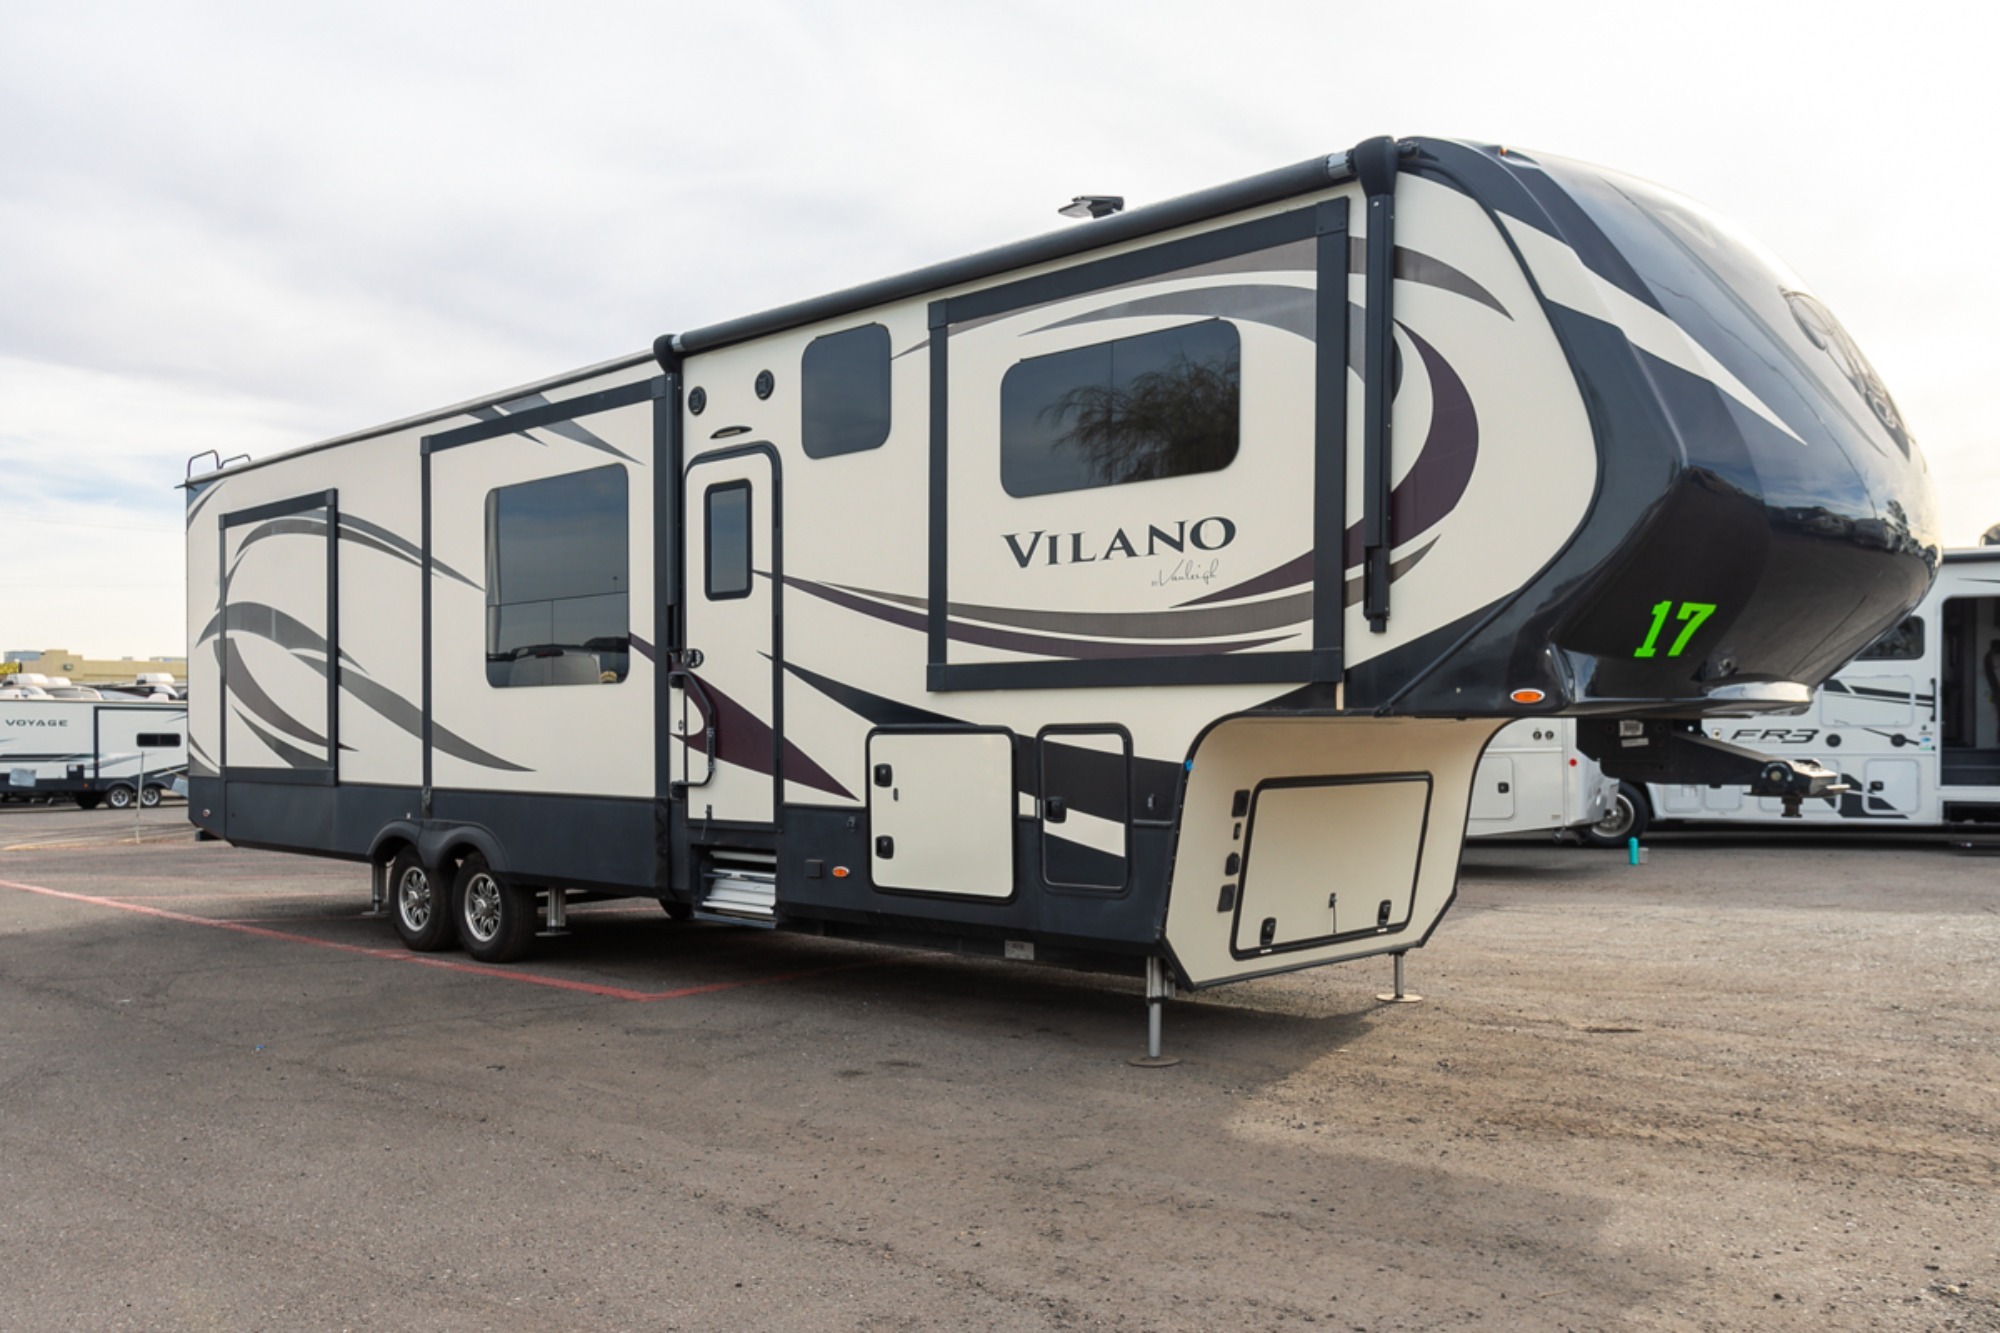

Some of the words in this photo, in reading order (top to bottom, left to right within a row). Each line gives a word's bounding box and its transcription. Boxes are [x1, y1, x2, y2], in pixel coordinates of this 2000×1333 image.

[1000, 516, 1237, 569] VILANO
[1633, 600, 1717, 657] 17
[4, 719, 69, 727] VOYAGE
[1731, 729, 1819, 744] FR3
